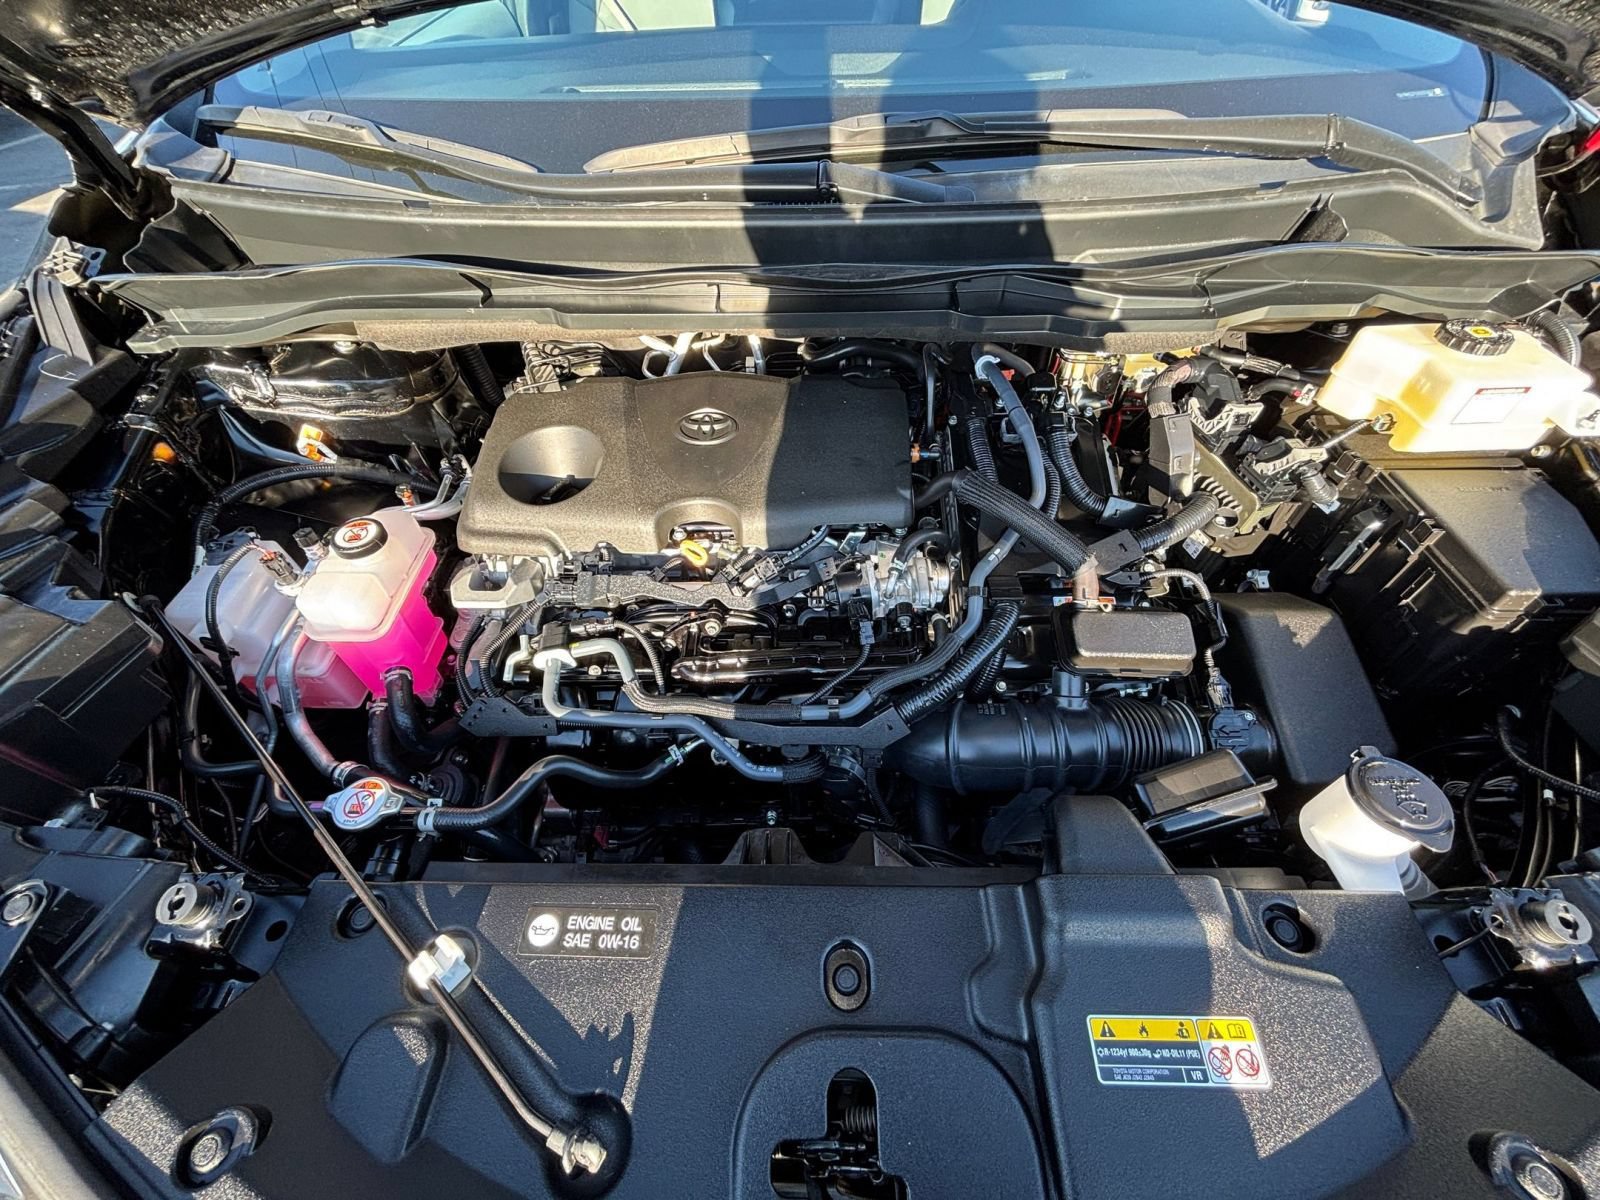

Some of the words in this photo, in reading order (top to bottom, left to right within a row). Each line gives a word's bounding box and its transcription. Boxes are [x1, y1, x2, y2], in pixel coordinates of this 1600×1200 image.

[567, 916, 615, 930] ENGINE
[621, 917, 642, 931] OIL
[563, 933, 592, 948] SAE
[598, 934, 640, 949] 0W-16
[1190, 1070, 1204, 1081] VR
